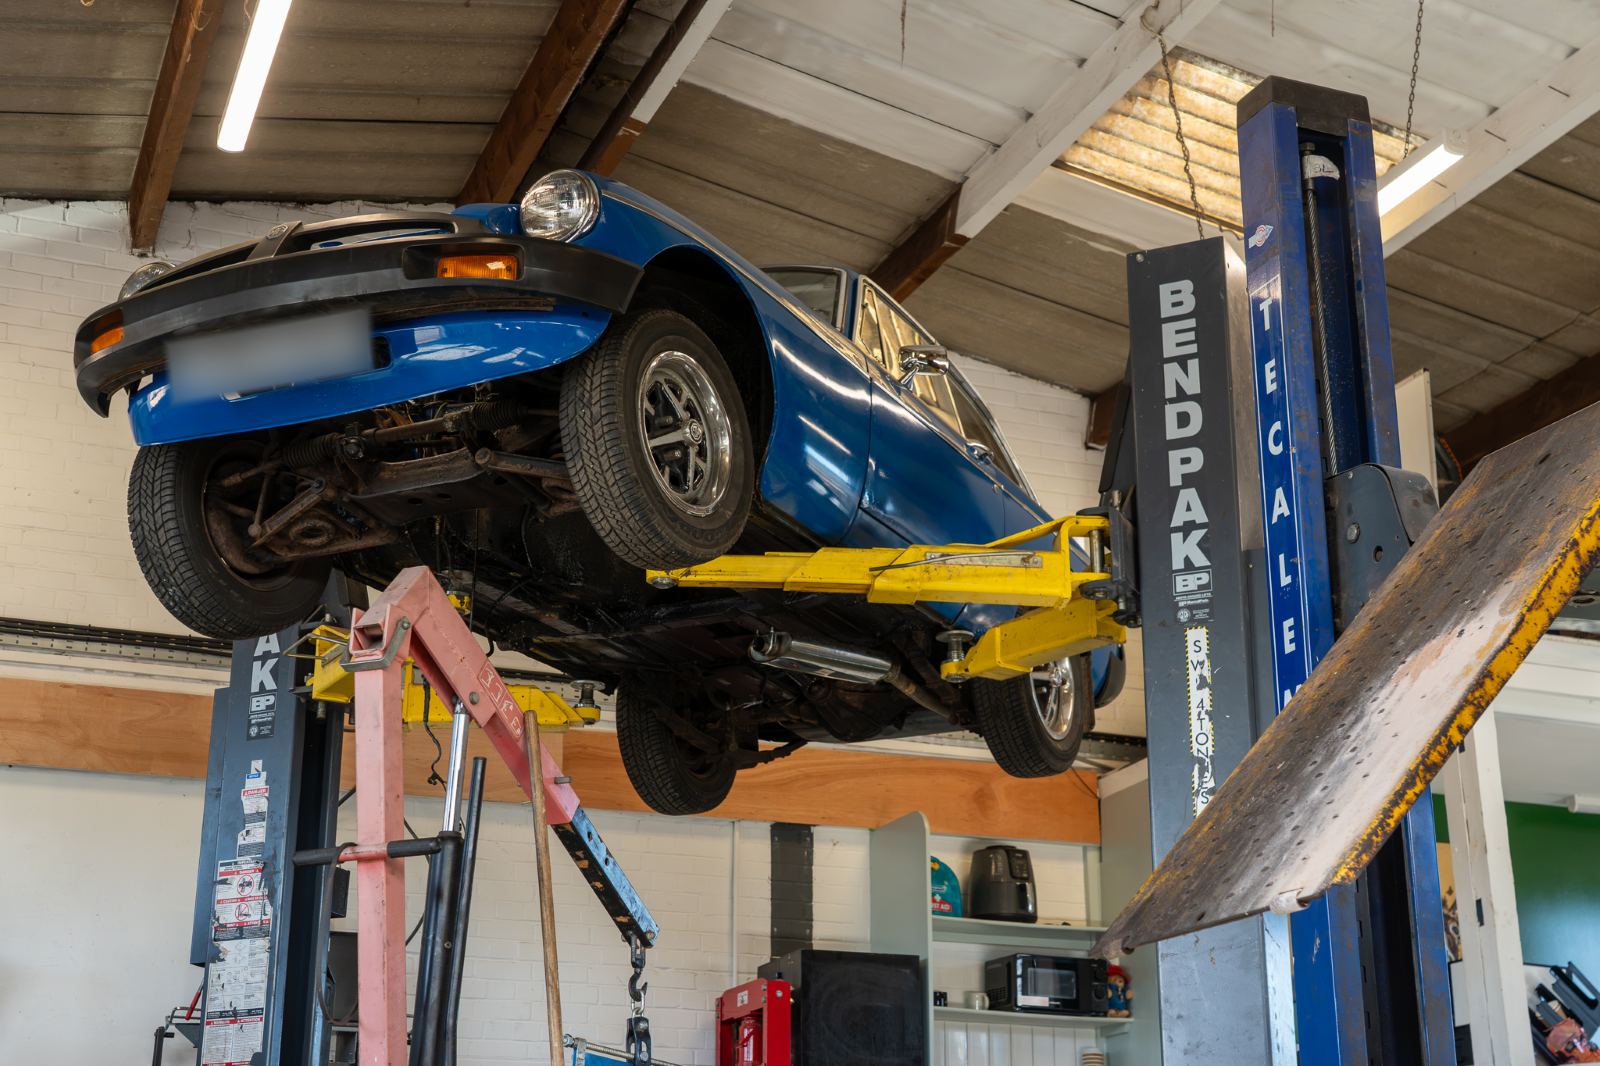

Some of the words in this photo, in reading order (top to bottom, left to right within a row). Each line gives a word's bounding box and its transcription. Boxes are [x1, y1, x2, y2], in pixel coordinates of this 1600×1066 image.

[1159, 279, 1212, 571] BENDPAK
[1175, 572, 1210, 593] BP
[250, 694, 276, 712] BP
[1196, 698, 1205, 711] 4
[1195, 717, 1210, 804] TONES
